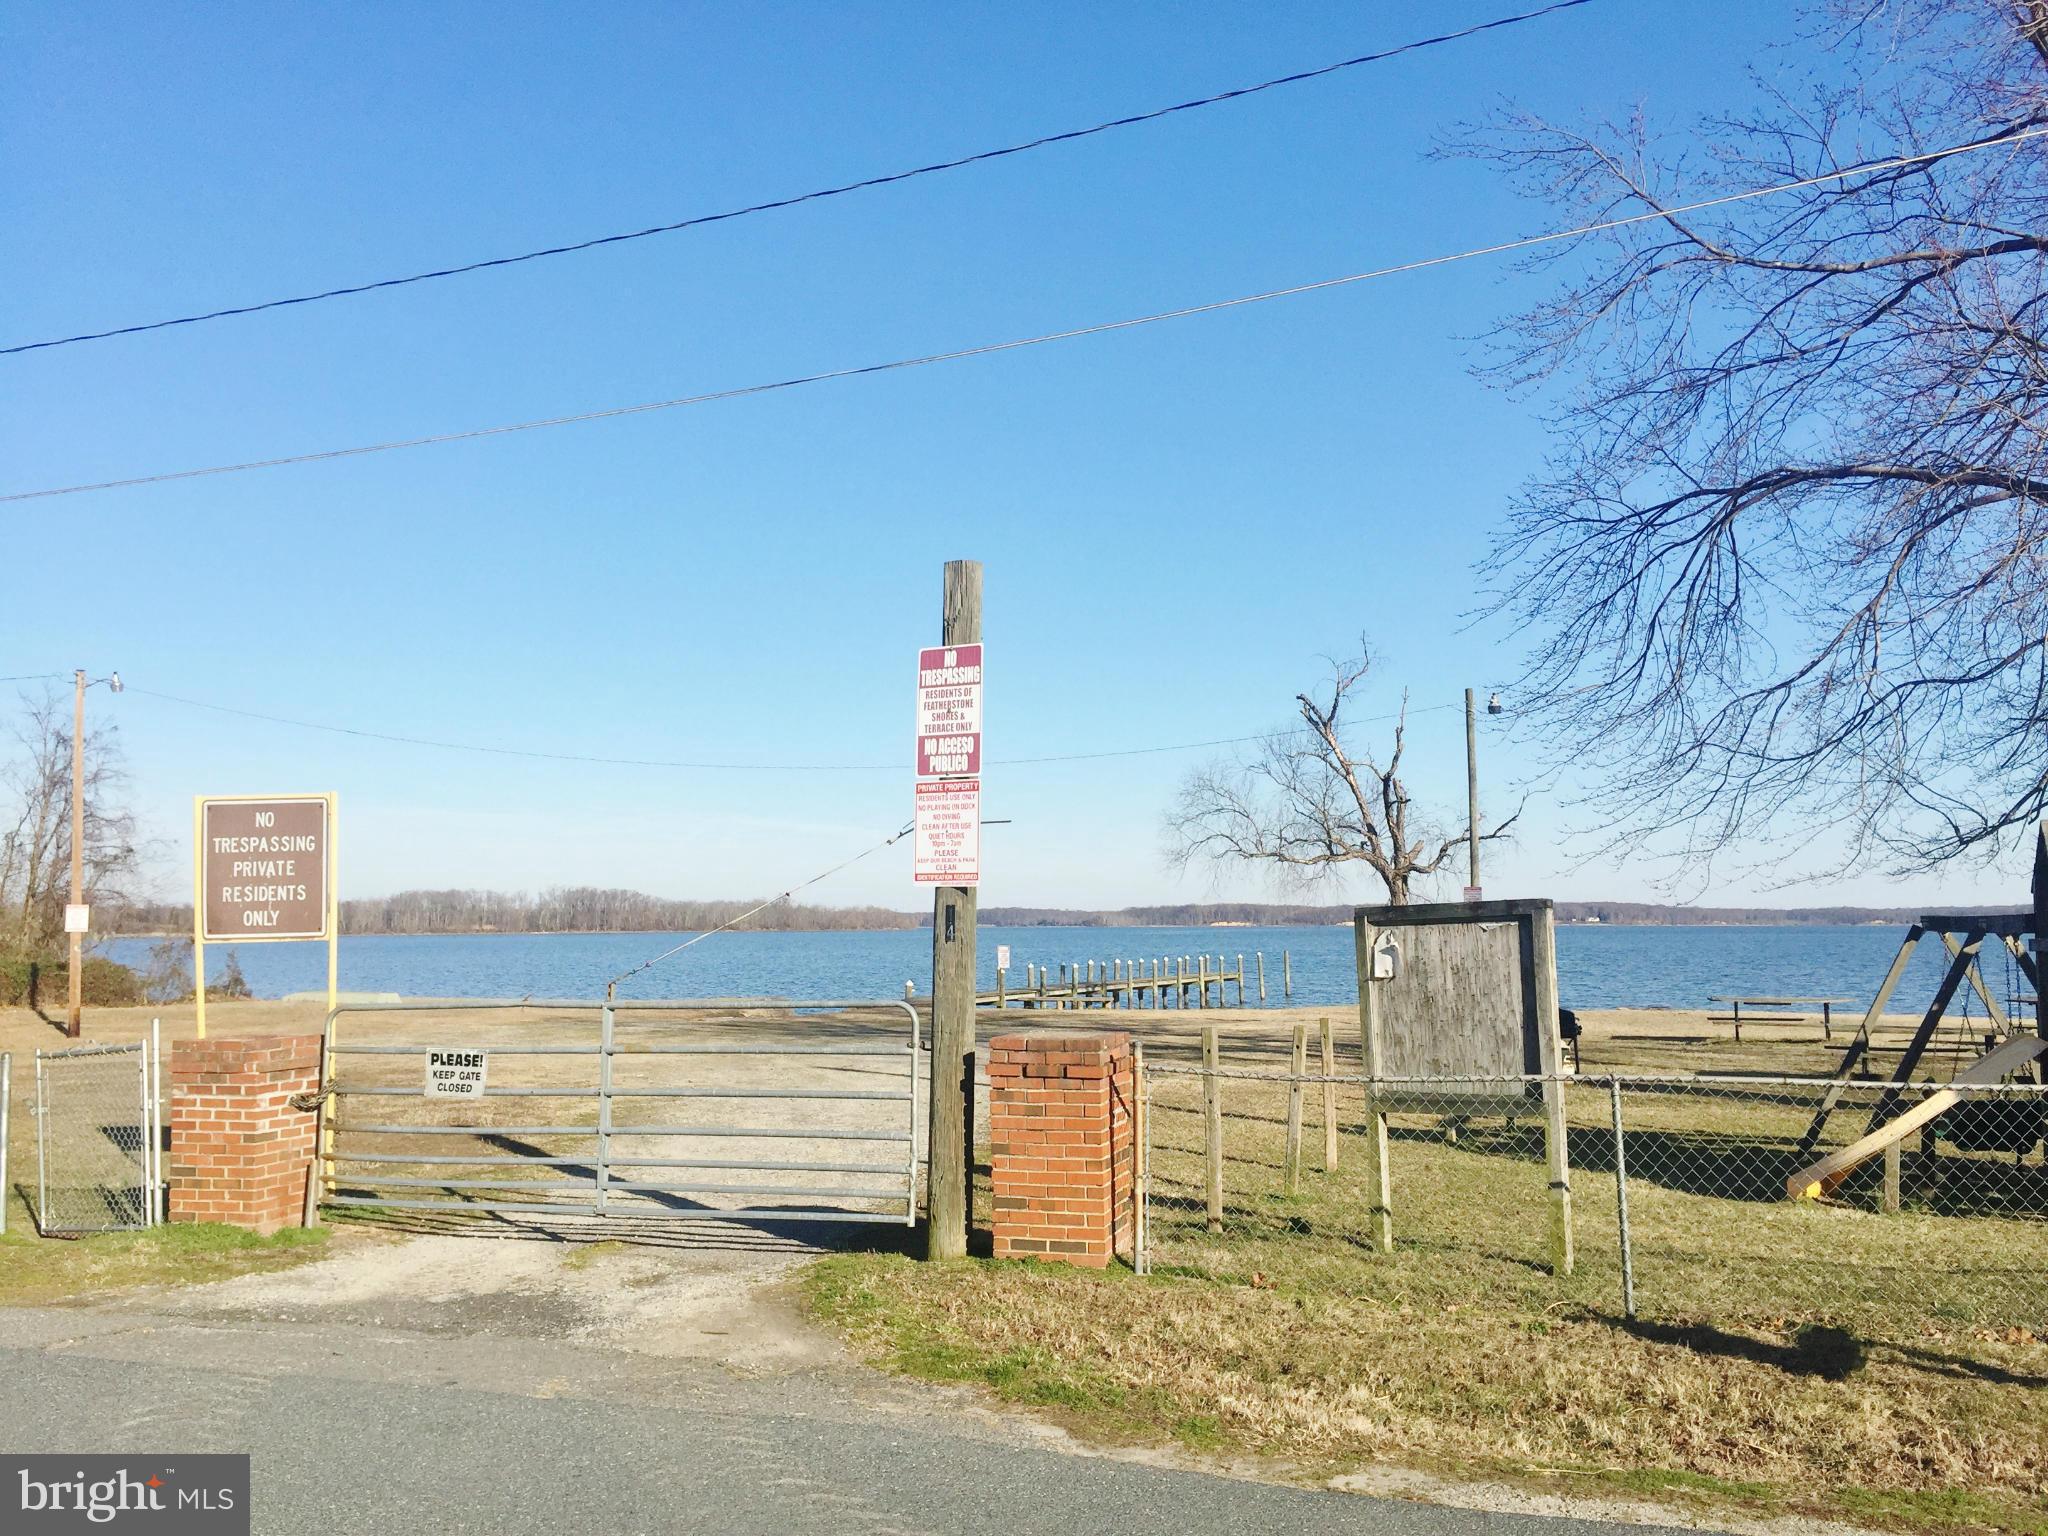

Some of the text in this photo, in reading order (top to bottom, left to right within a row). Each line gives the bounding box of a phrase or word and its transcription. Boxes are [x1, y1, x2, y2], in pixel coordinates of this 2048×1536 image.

[944, 650, 957, 668] NO
[920, 665, 980, 686] TRESPASSING
[925, 687, 972, 699] RESIDENTS OF
[924, 699, 974, 711] FEATHERSTONE
[931, 711, 965, 722] SHORES &
[924, 721, 973, 734] TERRACE ONLY
[924, 736, 974, 755] NO ACCESO
[929, 754, 968, 772] PUBLICO
[917, 782, 978, 792] PRIVATE PROPERTY
[255, 811, 275, 828] NO
[212, 835, 316, 853] TRESPASSING
[233, 860, 295, 877] PRIVATE
[222, 884, 306, 902] RESIDENTS
[243, 910, 280, 926] ONLY
[430, 1052, 484, 1068] PLEASE!
[432, 1070, 481, 1081] KEEP GATE
[437, 1082, 473, 1093] CLOSED
